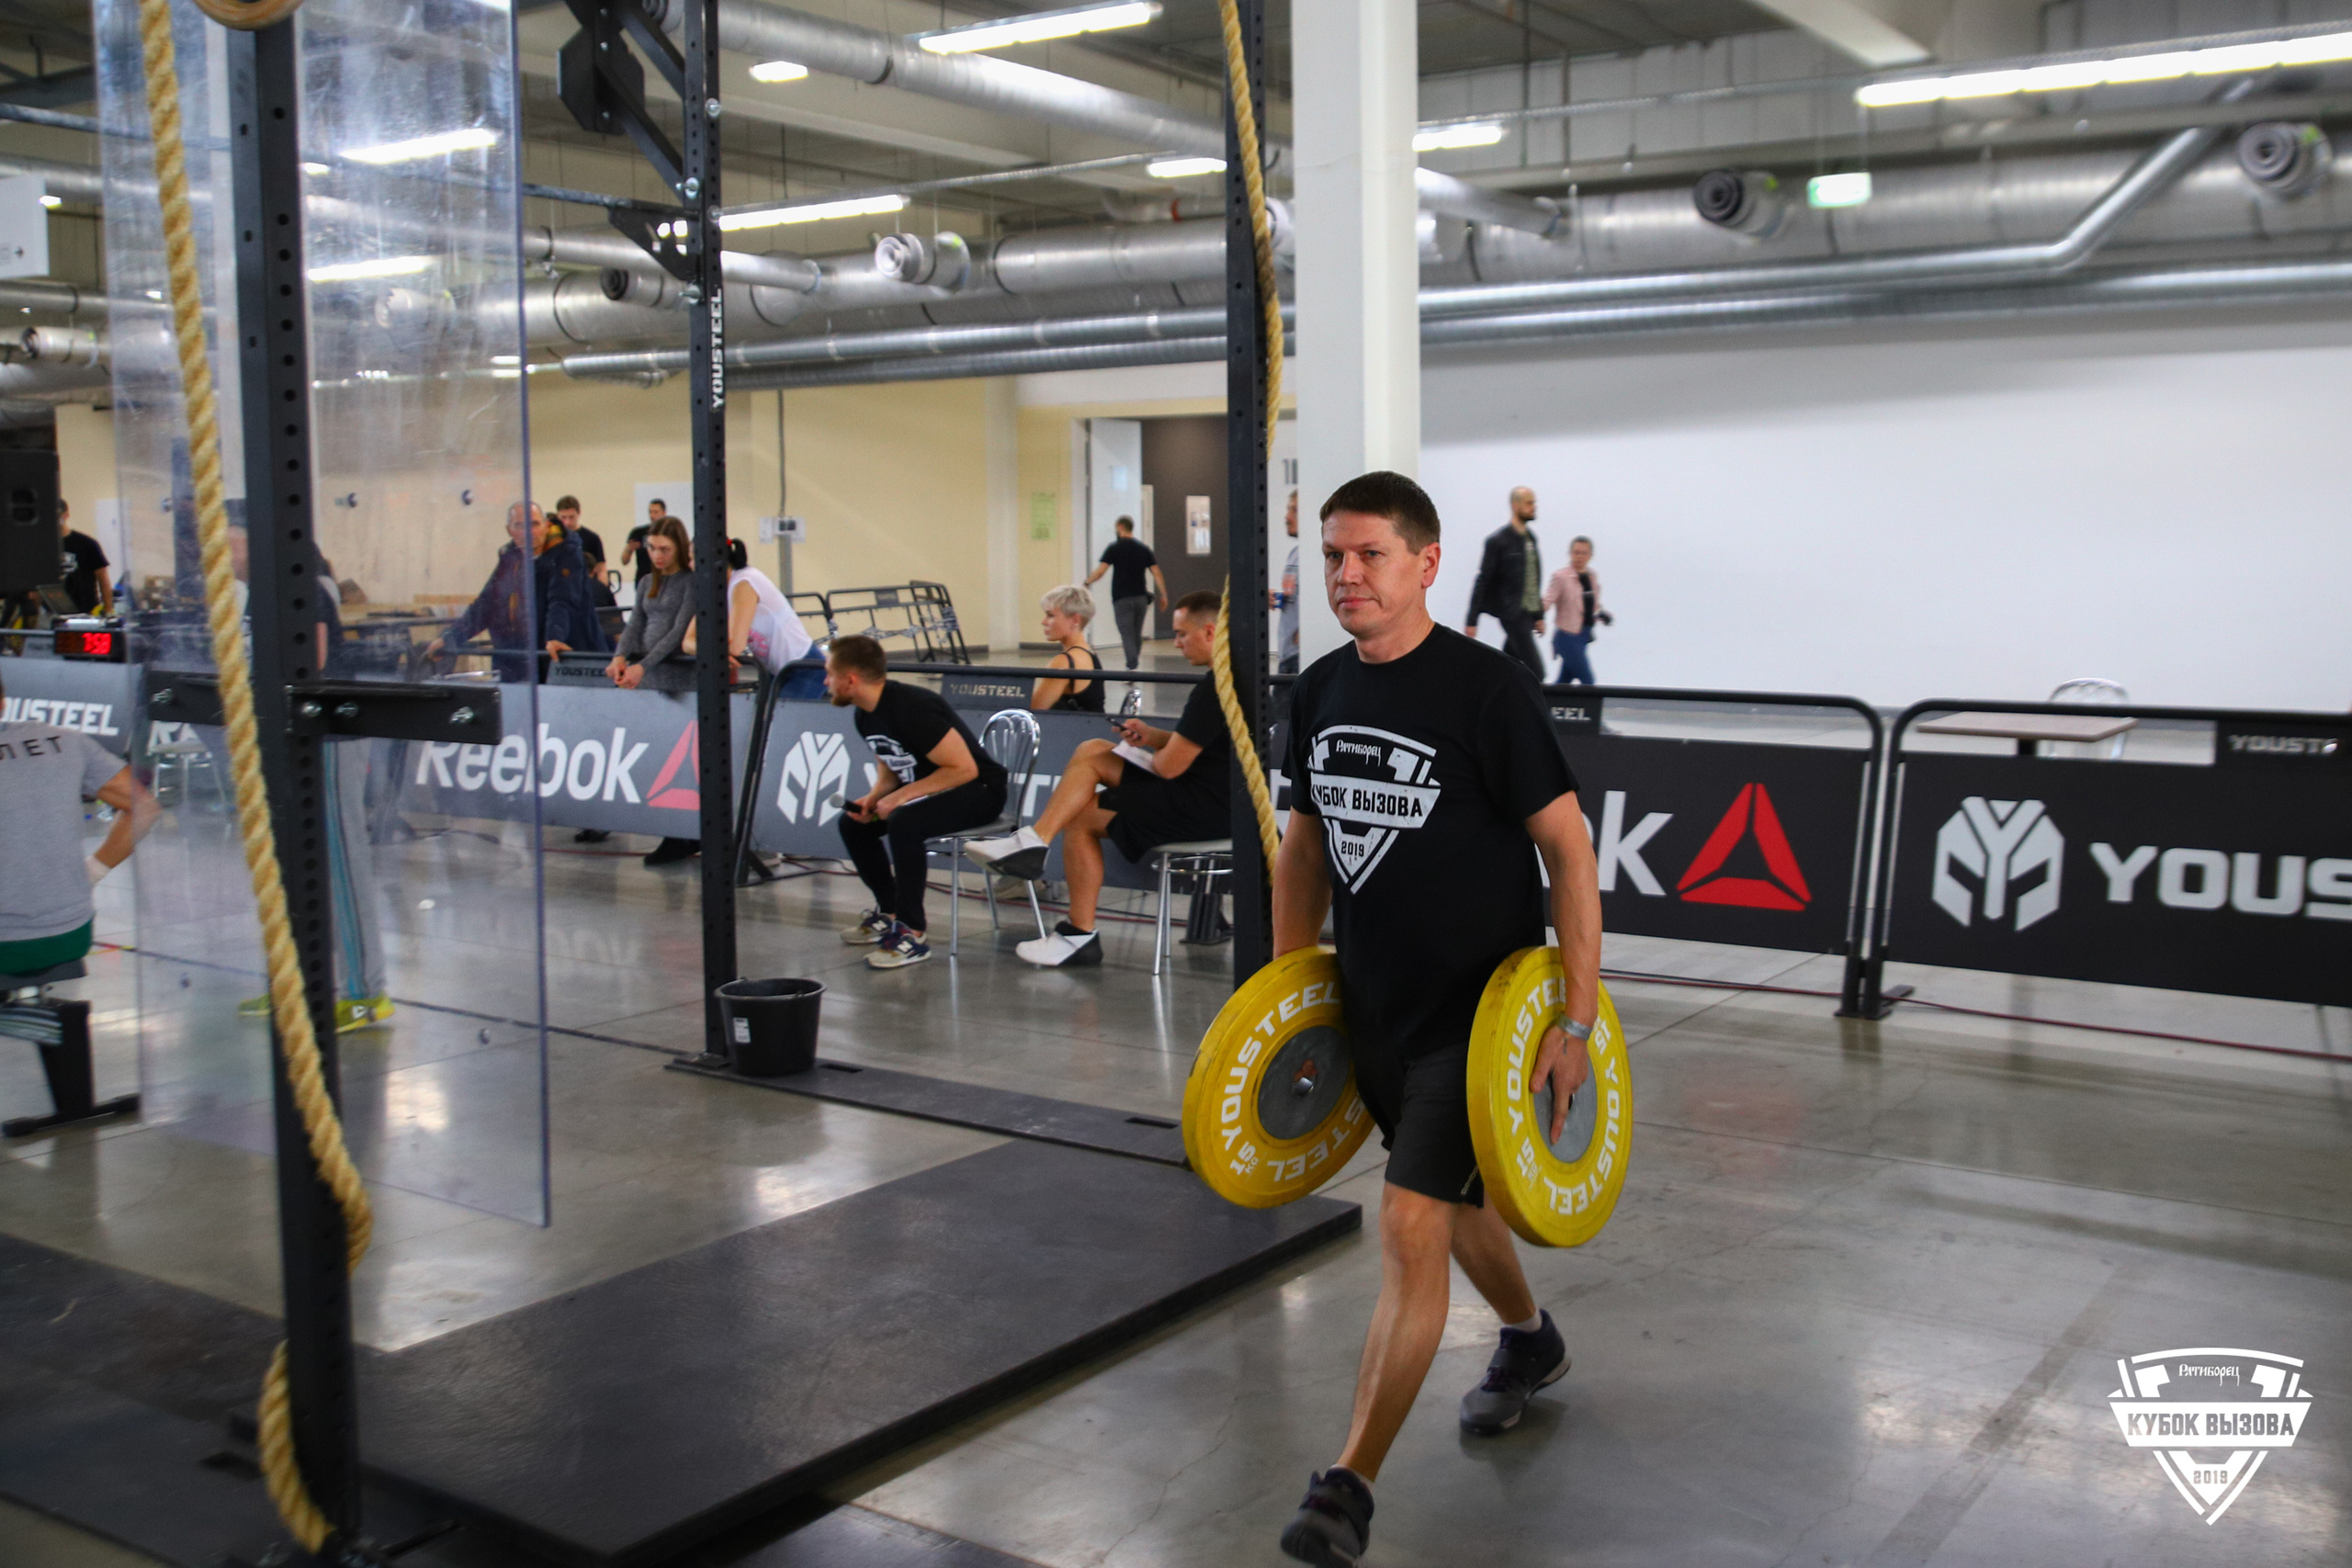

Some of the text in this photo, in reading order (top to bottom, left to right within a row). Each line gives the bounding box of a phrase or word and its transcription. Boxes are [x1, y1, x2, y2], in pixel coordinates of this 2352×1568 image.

[711, 288, 724, 408] YOUSTEEL
[555, 666, 606, 677] YOUSTEE
[949, 683, 1025, 697] YOUSTEEL
[2229, 735, 2320, 753] YOUST
[415, 722, 650, 804] Reebok
[1352, 788, 1423, 818] ВЫЗОВА
[1341, 840, 1364, 857] 2019
[1220, 981, 1340, 1151] YOUSTEEL
[1544, 1056, 1620, 1215] YOUSTEEL
[1230, 1141, 1256, 1176] 15
